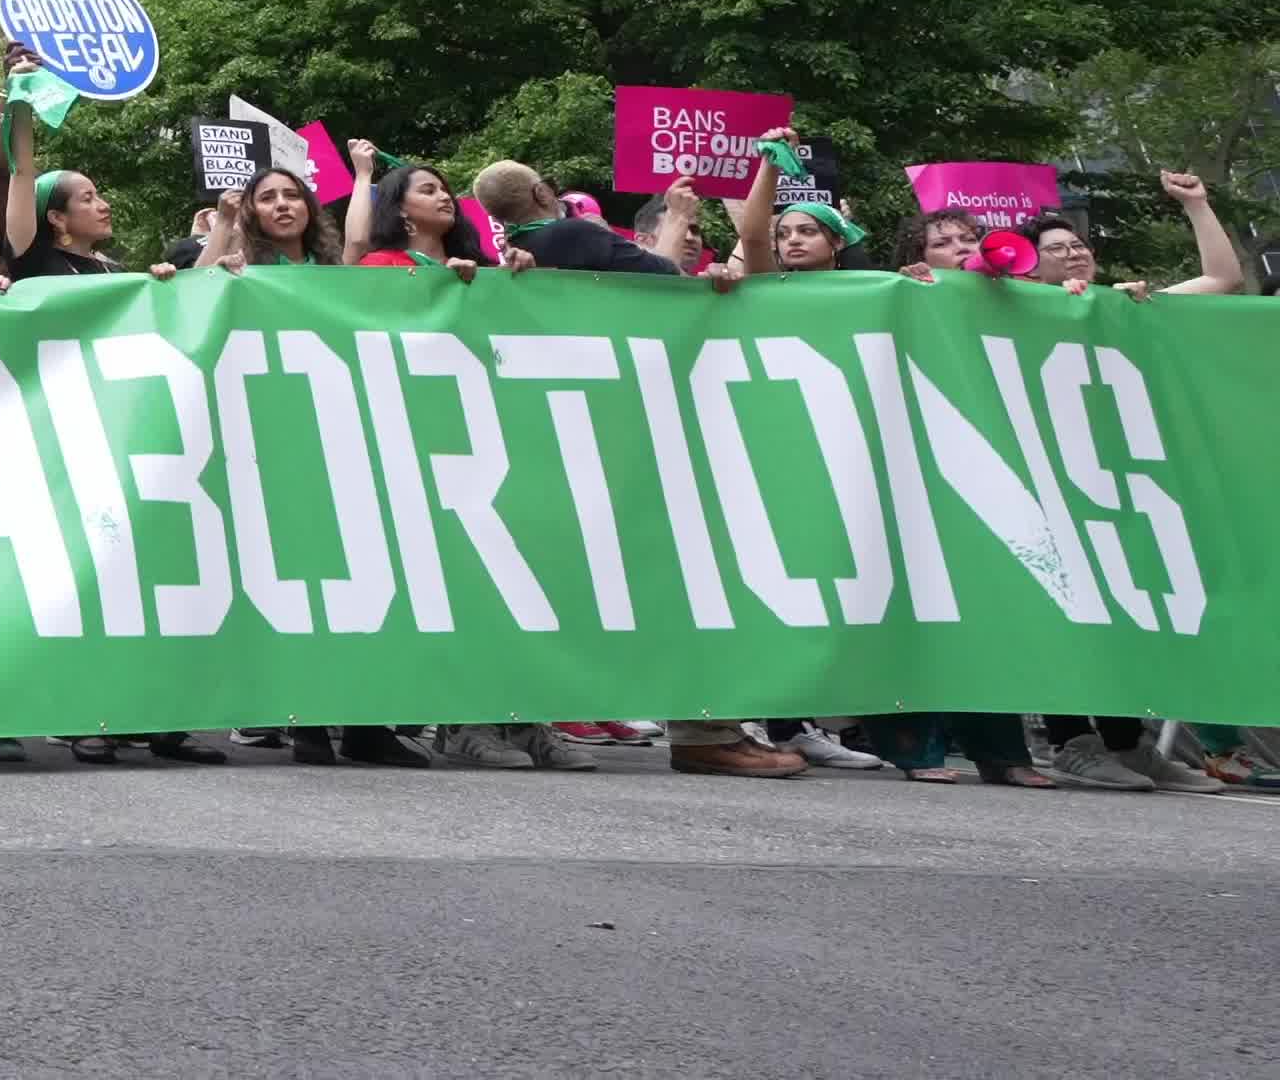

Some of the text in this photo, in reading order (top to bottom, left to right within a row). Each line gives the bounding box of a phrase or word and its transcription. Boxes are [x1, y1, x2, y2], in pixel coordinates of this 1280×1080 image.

[31, 32, 145, 72] LEGAL
[653, 107, 726, 133] BANS
[202, 128, 250, 141] STAND
[651, 130, 708, 154] OFF
[204, 144, 244, 156] WITH
[206, 159, 253, 172] BLACK
[652, 151, 750, 180] BODIES
[208, 176, 251, 188] WOM
[780, 176, 814, 187] ACK
[778, 191, 829, 202] OMEN
[947, 191, 1033, 209] Abortion is
